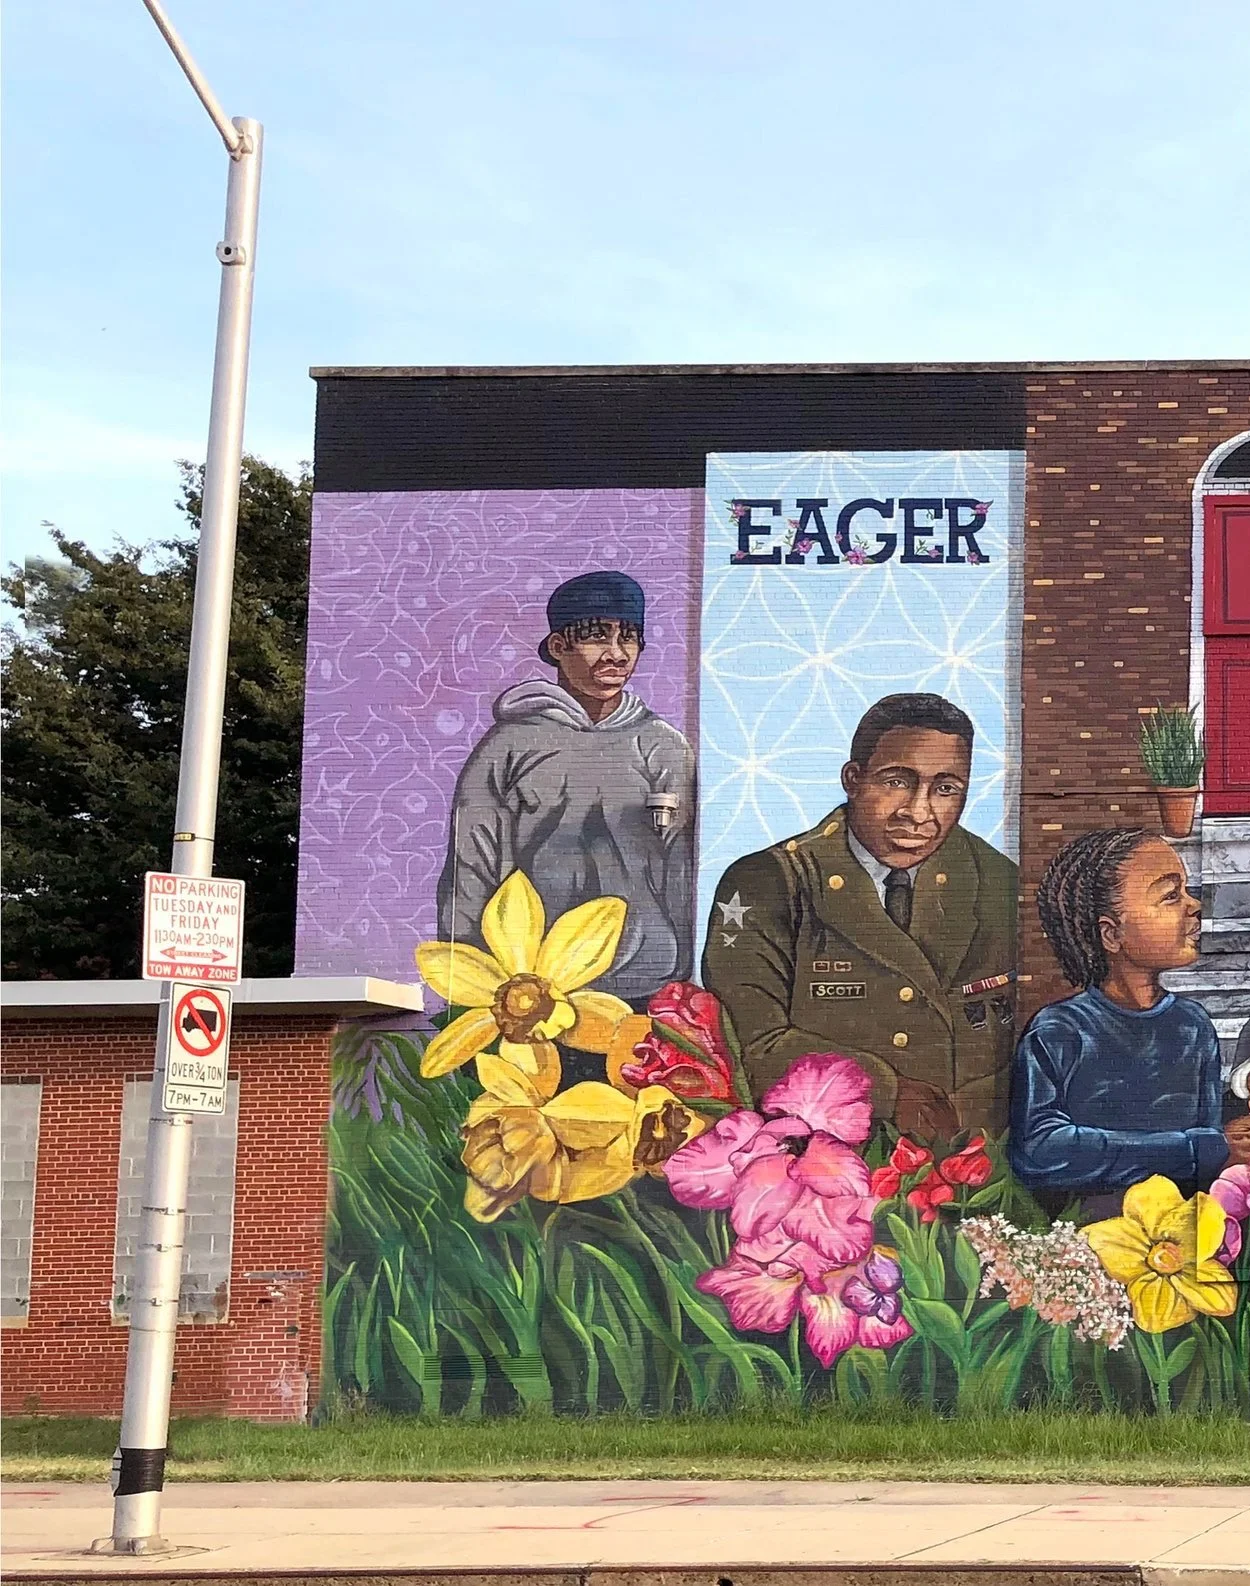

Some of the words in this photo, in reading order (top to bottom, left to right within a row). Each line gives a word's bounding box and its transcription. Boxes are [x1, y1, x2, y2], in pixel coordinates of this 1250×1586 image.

[730, 497, 992, 565] EAGER
[151, 877, 175, 893] NO
[180, 881, 238, 899] PARKING
[153, 897, 214, 914] TUESDAY
[215, 904, 237, 915] AND
[171, 914, 219, 930] FRIDAY
[149, 963, 172, 975] TOW
[174, 965, 206, 977] AWAY
[207, 967, 237, 980] ZONE
[816, 985, 862, 997] SCOTT
[171, 1062, 194, 1078] OVER
[207, 1065, 222, 1080] TON
